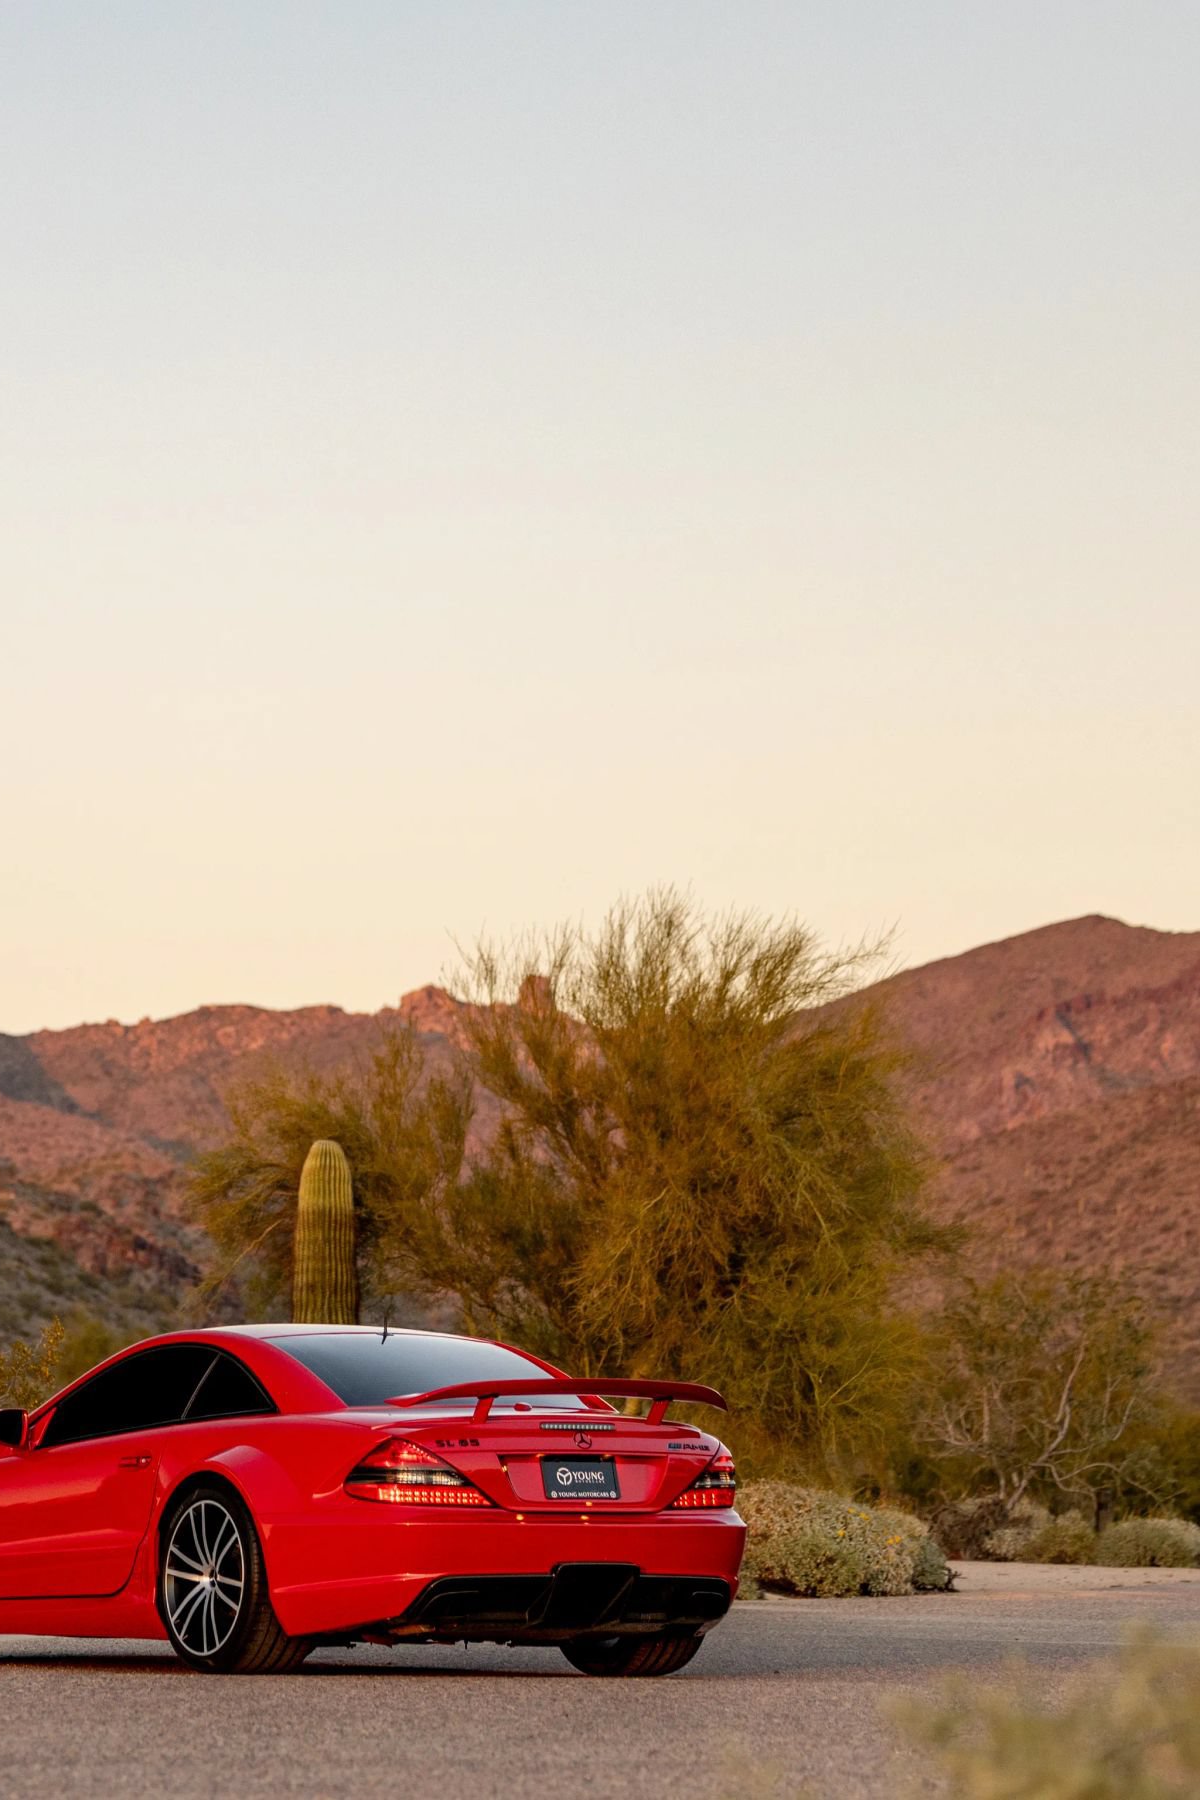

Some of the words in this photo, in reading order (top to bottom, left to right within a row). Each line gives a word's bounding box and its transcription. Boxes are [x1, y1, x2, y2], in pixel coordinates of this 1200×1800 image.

[435, 1439, 454, 1448] SL
[458, 1439, 480, 1447] 65
[572, 1471, 604, 1481] YOUNG
